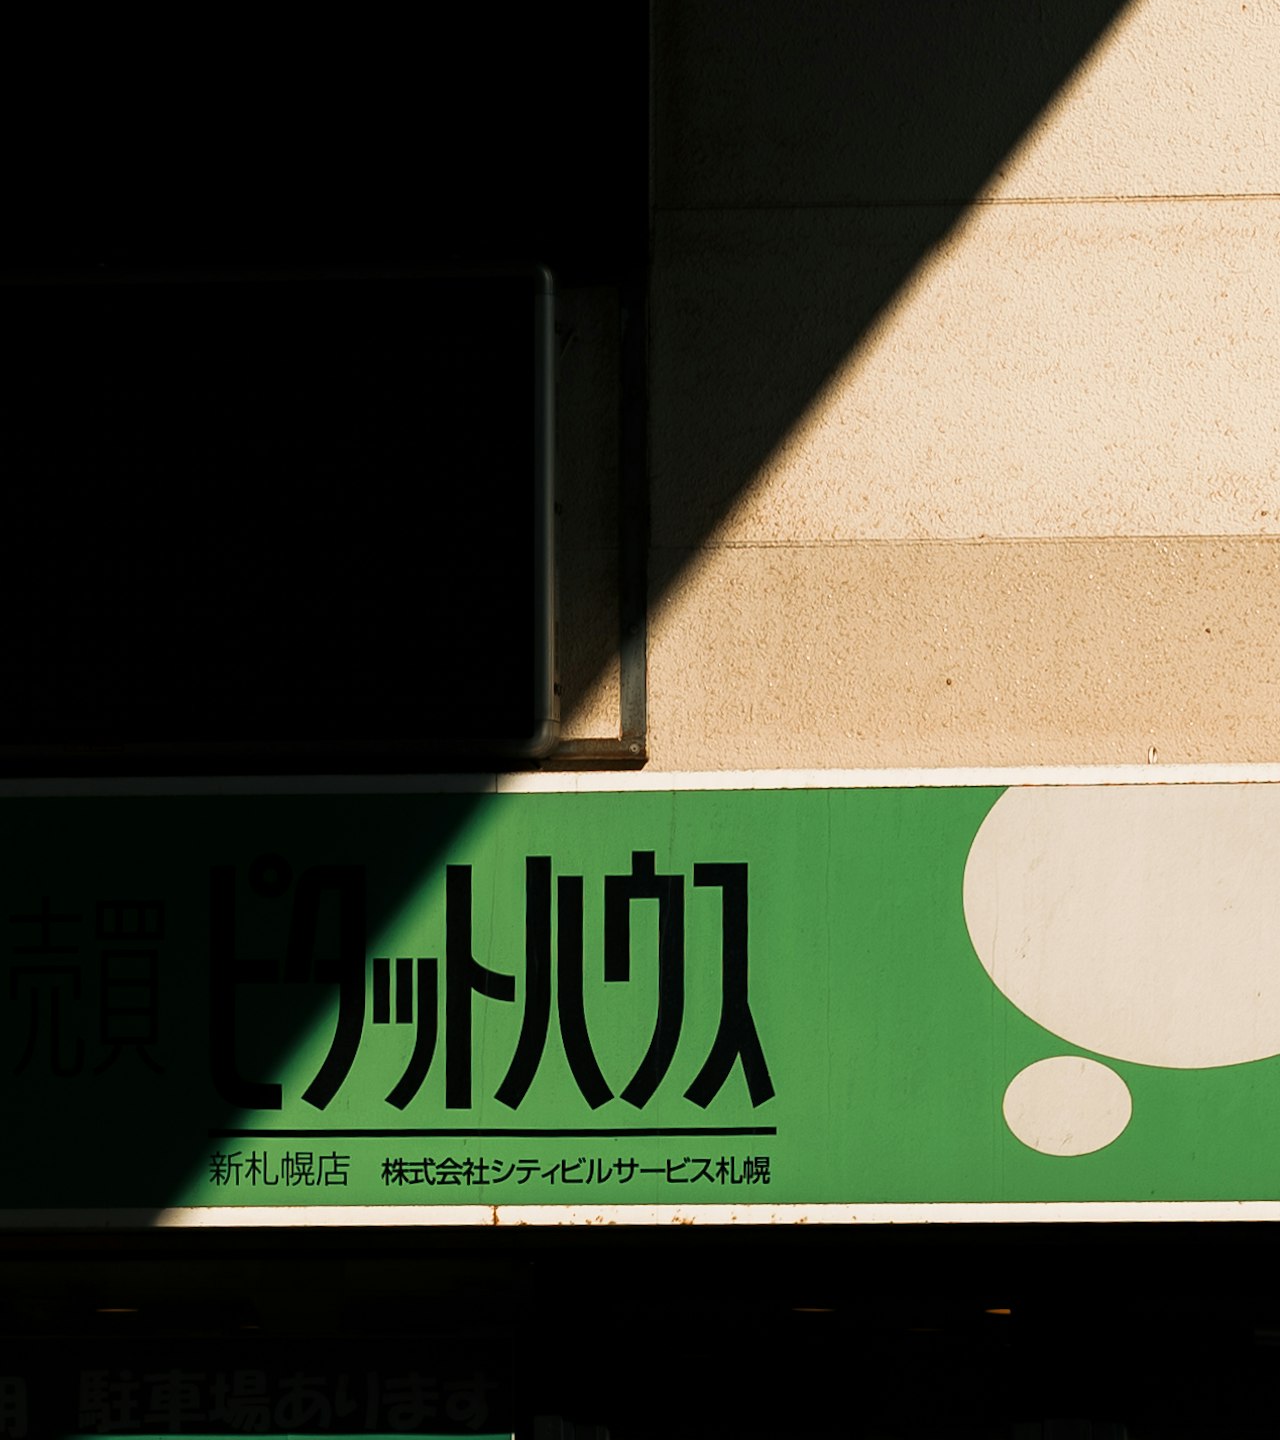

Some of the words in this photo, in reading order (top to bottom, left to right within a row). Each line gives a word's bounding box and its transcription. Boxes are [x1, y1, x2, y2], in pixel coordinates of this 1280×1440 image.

[209, 851, 775, 1110] ピタットハウス
[209, 1151, 350, 1187] 新札幌店
[381, 1156, 770, 1186] 株式会社シティビルサービス札幌
